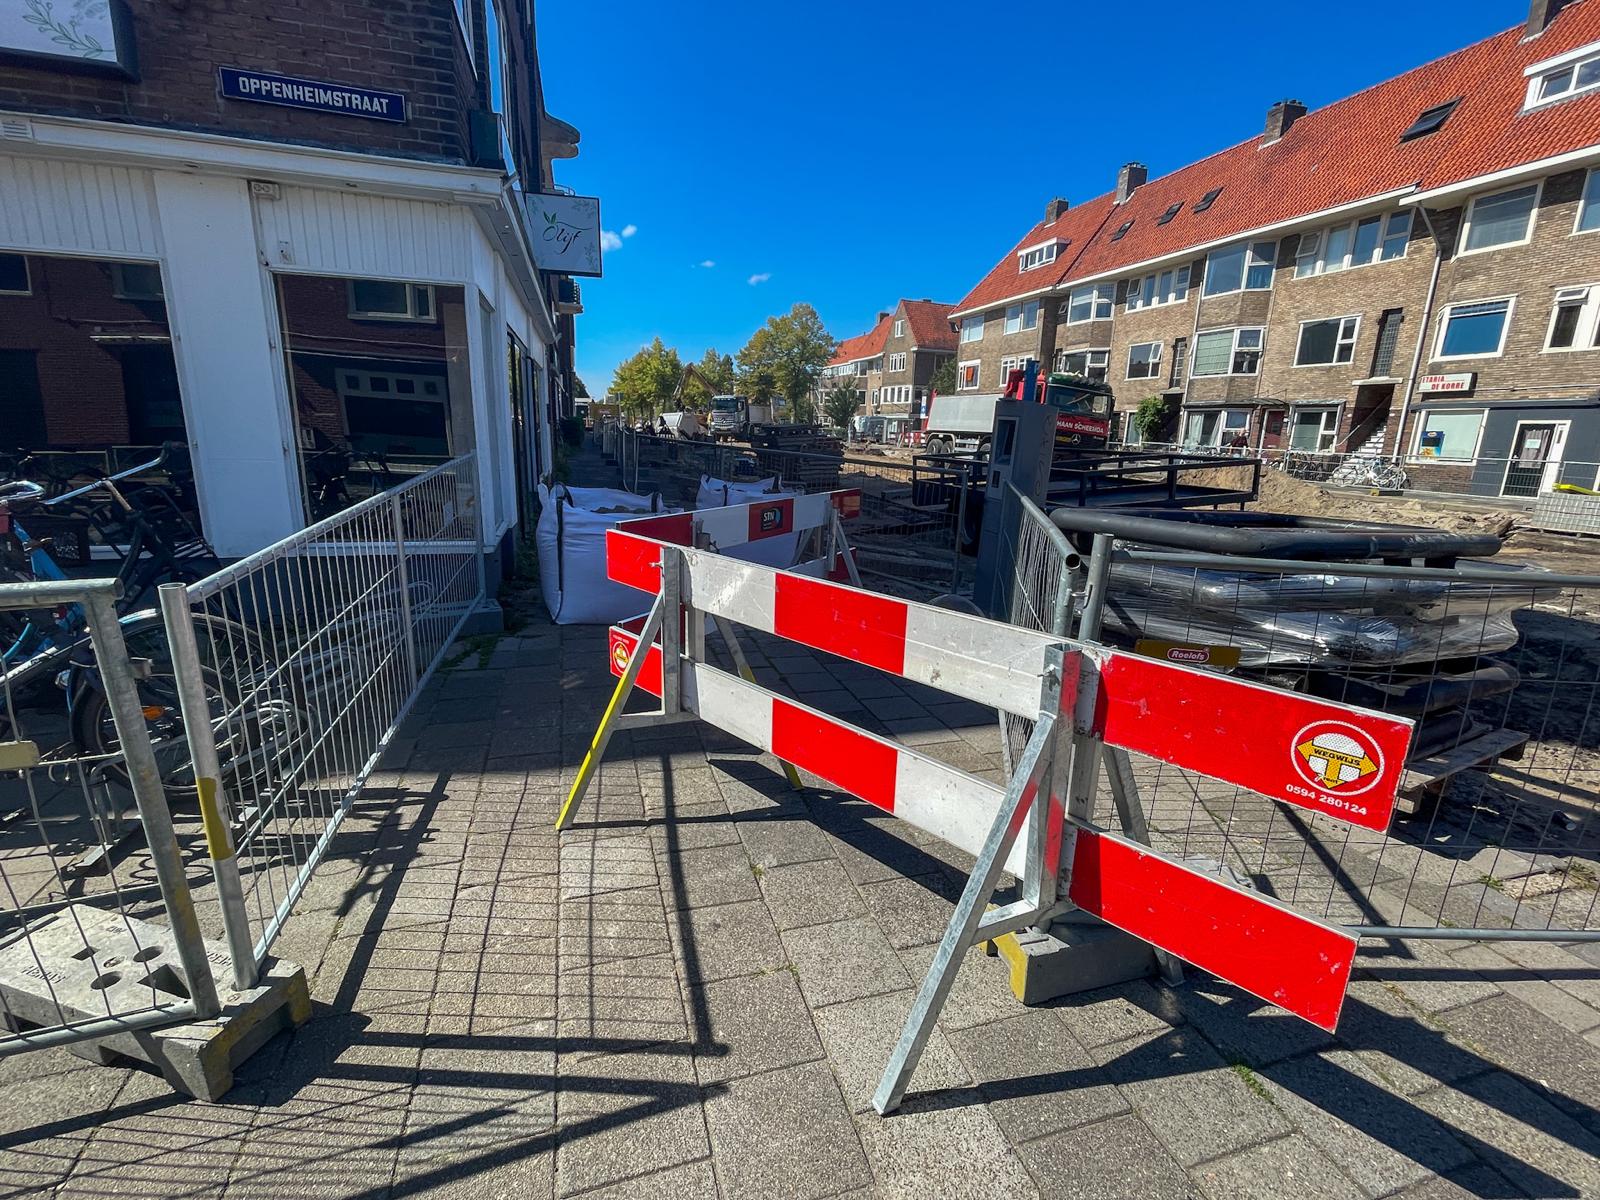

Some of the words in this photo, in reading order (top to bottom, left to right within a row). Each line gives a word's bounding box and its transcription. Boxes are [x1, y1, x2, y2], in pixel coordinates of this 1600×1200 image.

[239, 77, 388, 114] OPPENHEIMSTRAAT
[1171, 650, 1205, 660] Roelofs
[1313, 748, 1360, 766] WEGWIJS
[1286, 784, 1316, 799] 0594
[1319, 794, 1367, 815] 280124
